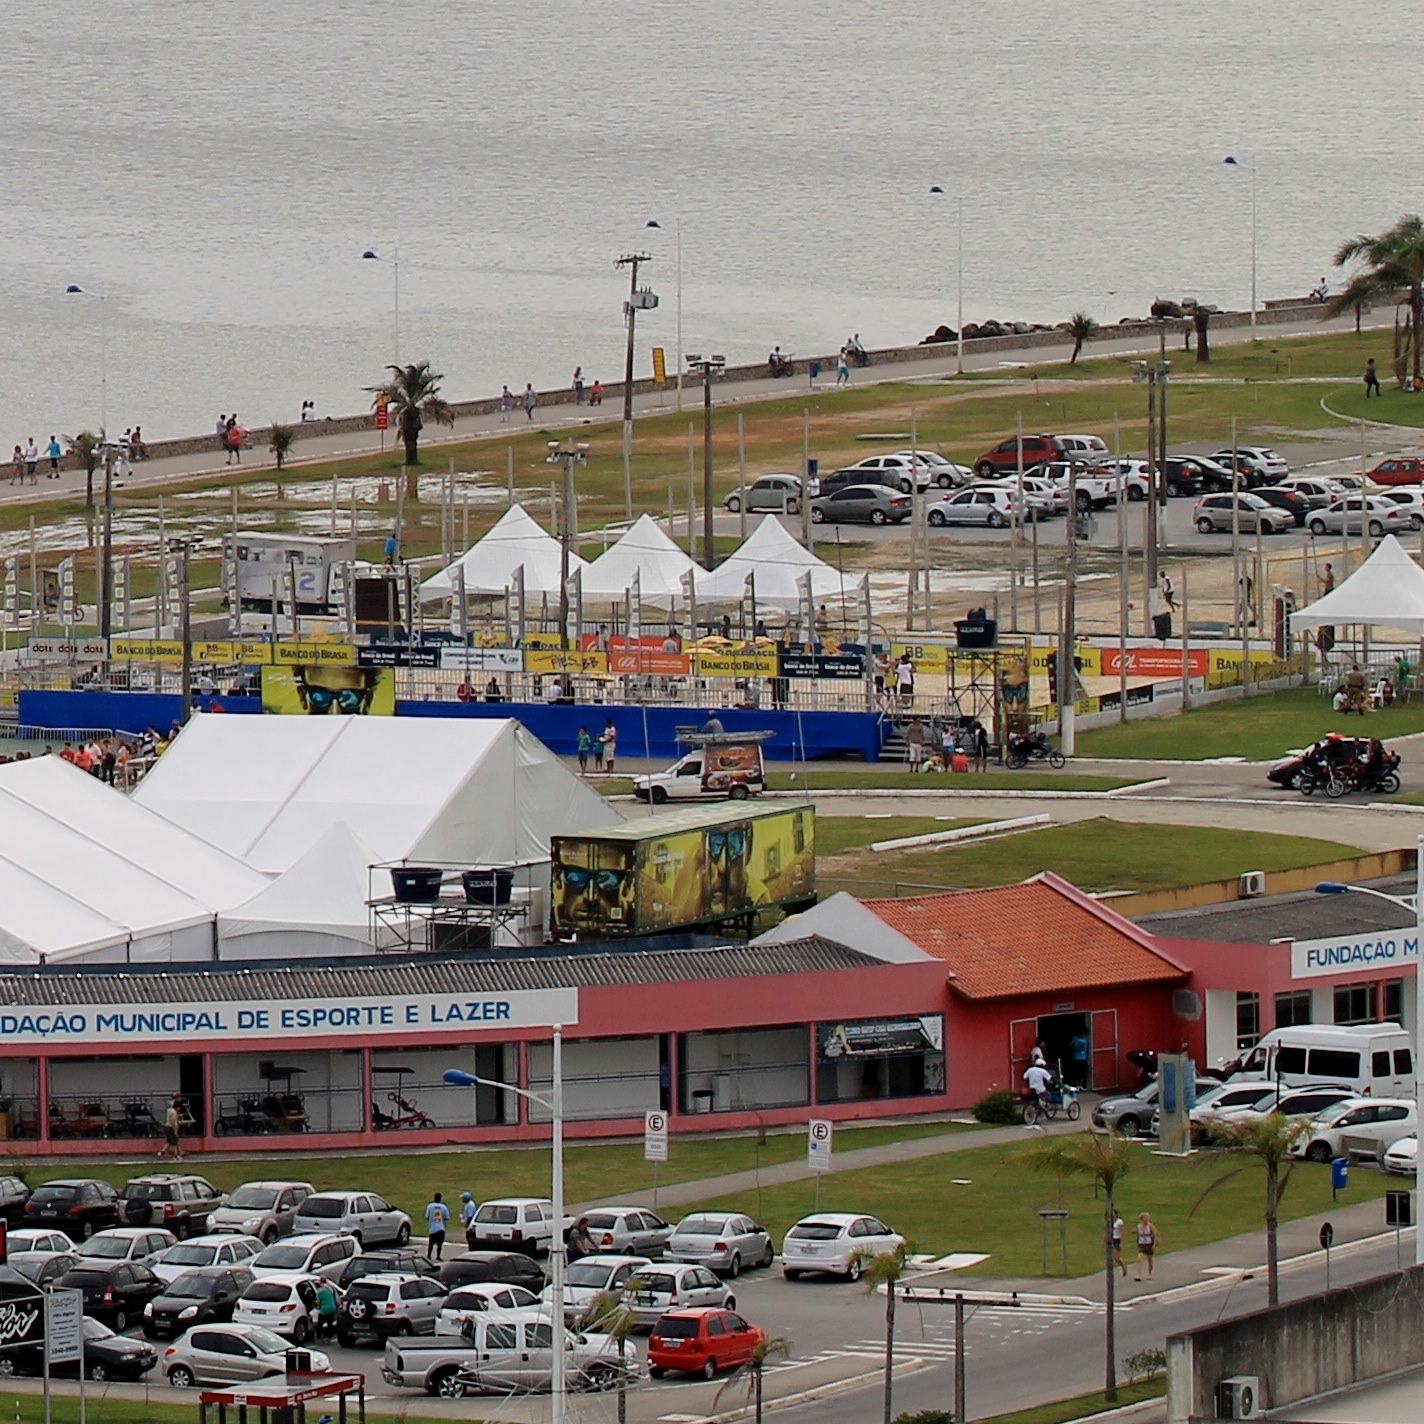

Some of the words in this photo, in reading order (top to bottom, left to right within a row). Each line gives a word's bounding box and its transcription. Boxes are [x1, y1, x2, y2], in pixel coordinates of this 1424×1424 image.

[280, 648, 309, 659] BANCO
[321, 649, 349, 660] BRASIL
[701, 659, 729, 671] BANCO
[743, 660, 771, 671] BRASIL
[1307, 938, 1396, 968] FUNDAÇÃO
[96, 1011, 228, 1033] MUNICIPAL
[237, 1010, 270, 1030] DE
[281, 1006, 393, 1028] ESPORTE
[406, 1005, 419, 1024] E
[430, 1001, 511, 1023] LAZER
